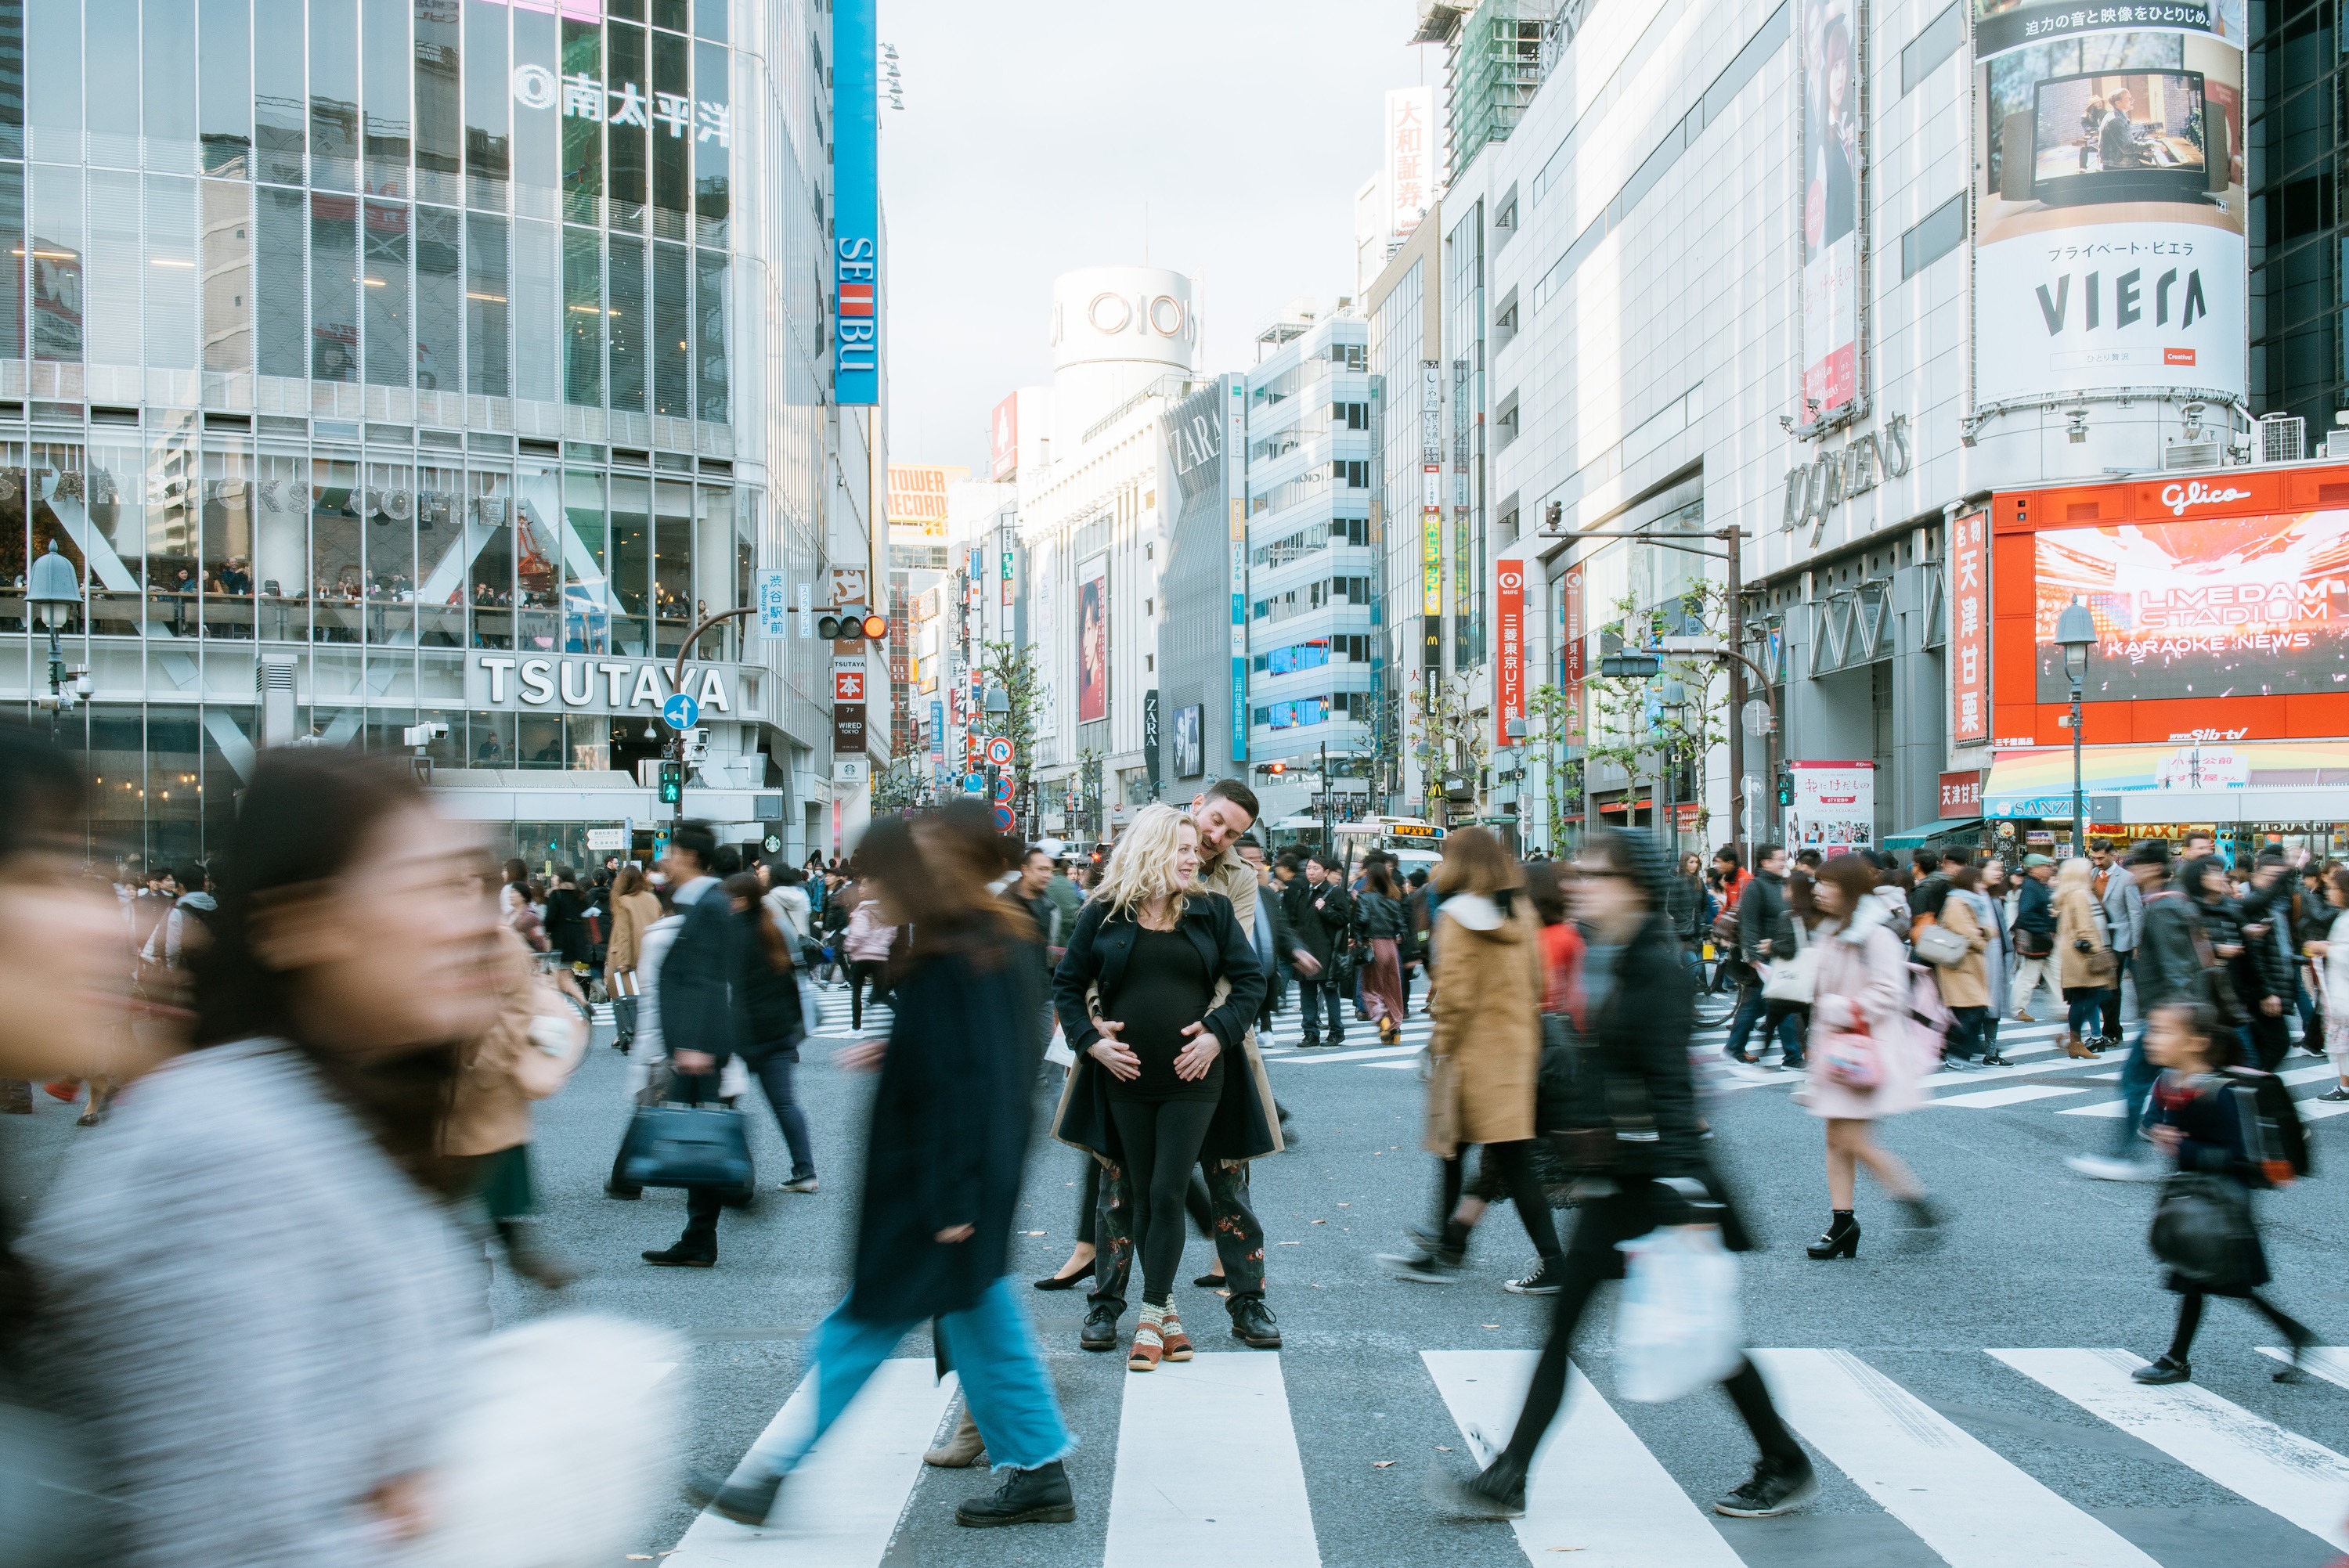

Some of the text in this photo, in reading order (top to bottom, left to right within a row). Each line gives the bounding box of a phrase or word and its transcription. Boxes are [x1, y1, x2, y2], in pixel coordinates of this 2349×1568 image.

[2025, 6, 2212, 36] 迫力の音と映像をひとりじめ。
[1395, 100, 1423, 209] 大和証券
[2049, 242, 2193, 261] プライベート・ビエラ
[839, 238, 875, 375] SEIBU
[2167, 352, 2193, 361] Creative!
[889, 470, 946, 493] TOWER
[888, 493, 948, 517] RECORD
[2161, 481, 2252, 516] Glico
[1233, 542, 1242, 580] パーソナル
[770, 575, 783, 634] 渋谷駅前
[2142, 582, 2328, 609] LIVE DAM
[2142, 602, 2328, 629] STADIUM
[1960, 550, 1979, 733] 天津甘栗
[2107, 633, 2310, 655] KARAOKE NEWS
[480, 657, 730, 712] TSUTAYA
[839, 675, 861, 697] 本
[1146, 699, 1158, 746] ZARA
[1994, 737, 2034, 746] 三千里薬品
[1805, 778, 1870, 793] 花にけだもの
[1942, 783, 1979, 806] 天津甘栗
[2133, 824, 2173, 838] TAX
